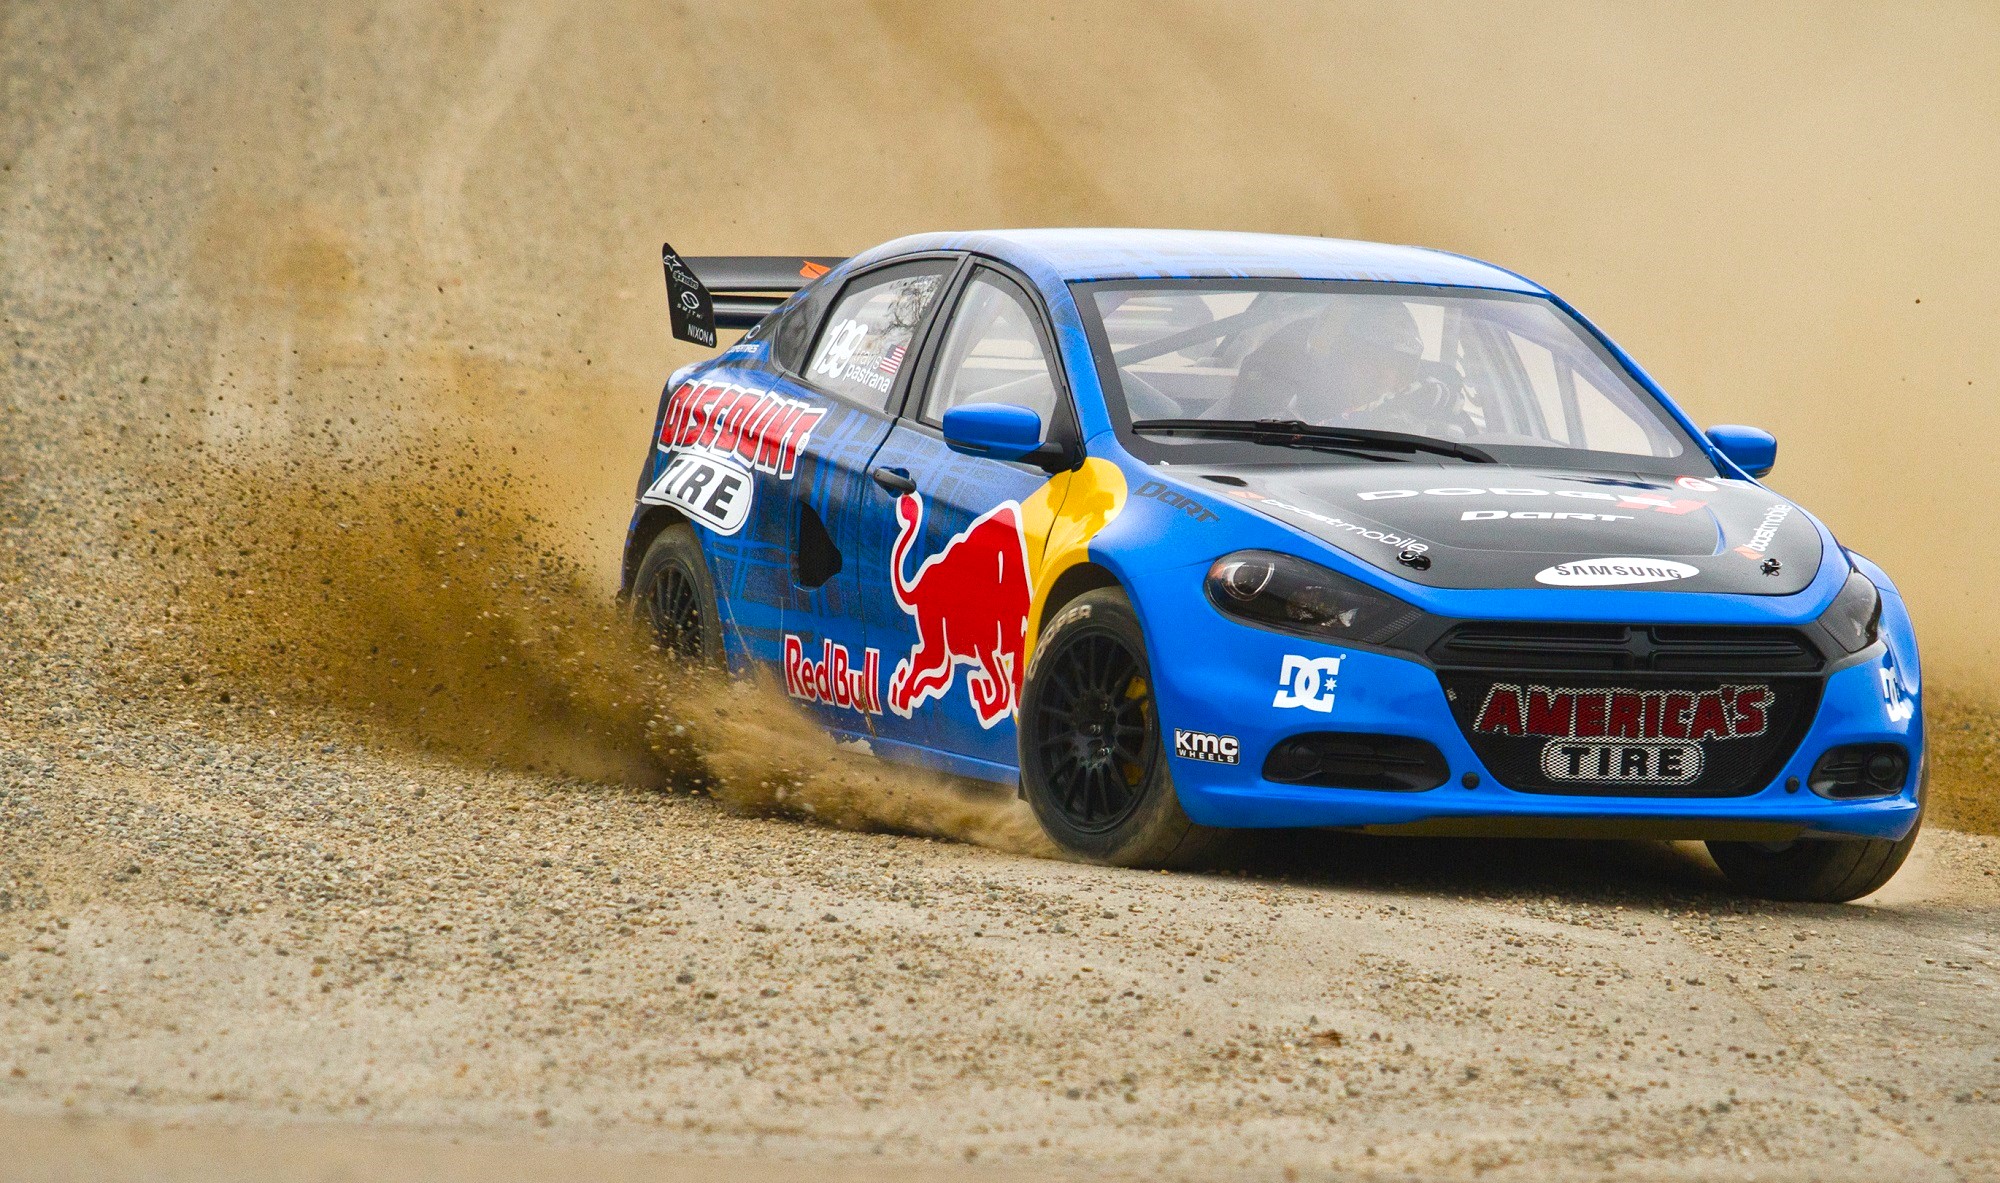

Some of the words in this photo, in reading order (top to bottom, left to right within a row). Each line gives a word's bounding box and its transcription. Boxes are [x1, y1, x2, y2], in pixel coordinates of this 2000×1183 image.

[688, 324, 710, 343] NIXON
[813, 319, 868, 378] 199
[843, 364, 891, 393] pastrana
[658, 379, 827, 479] DISCOUNT
[651, 458, 742, 521] TIRE
[1555, 563, 1681, 580] SAMSUNG
[784, 634, 835, 706] Red
[832, 643, 883, 716] Bull
[1272, 654, 1341, 713] DC
[1474, 683, 1770, 740] AMERICA'S
[1179, 749, 1235, 763] WHEELS
[1559, 747, 1689, 778] TIRE
